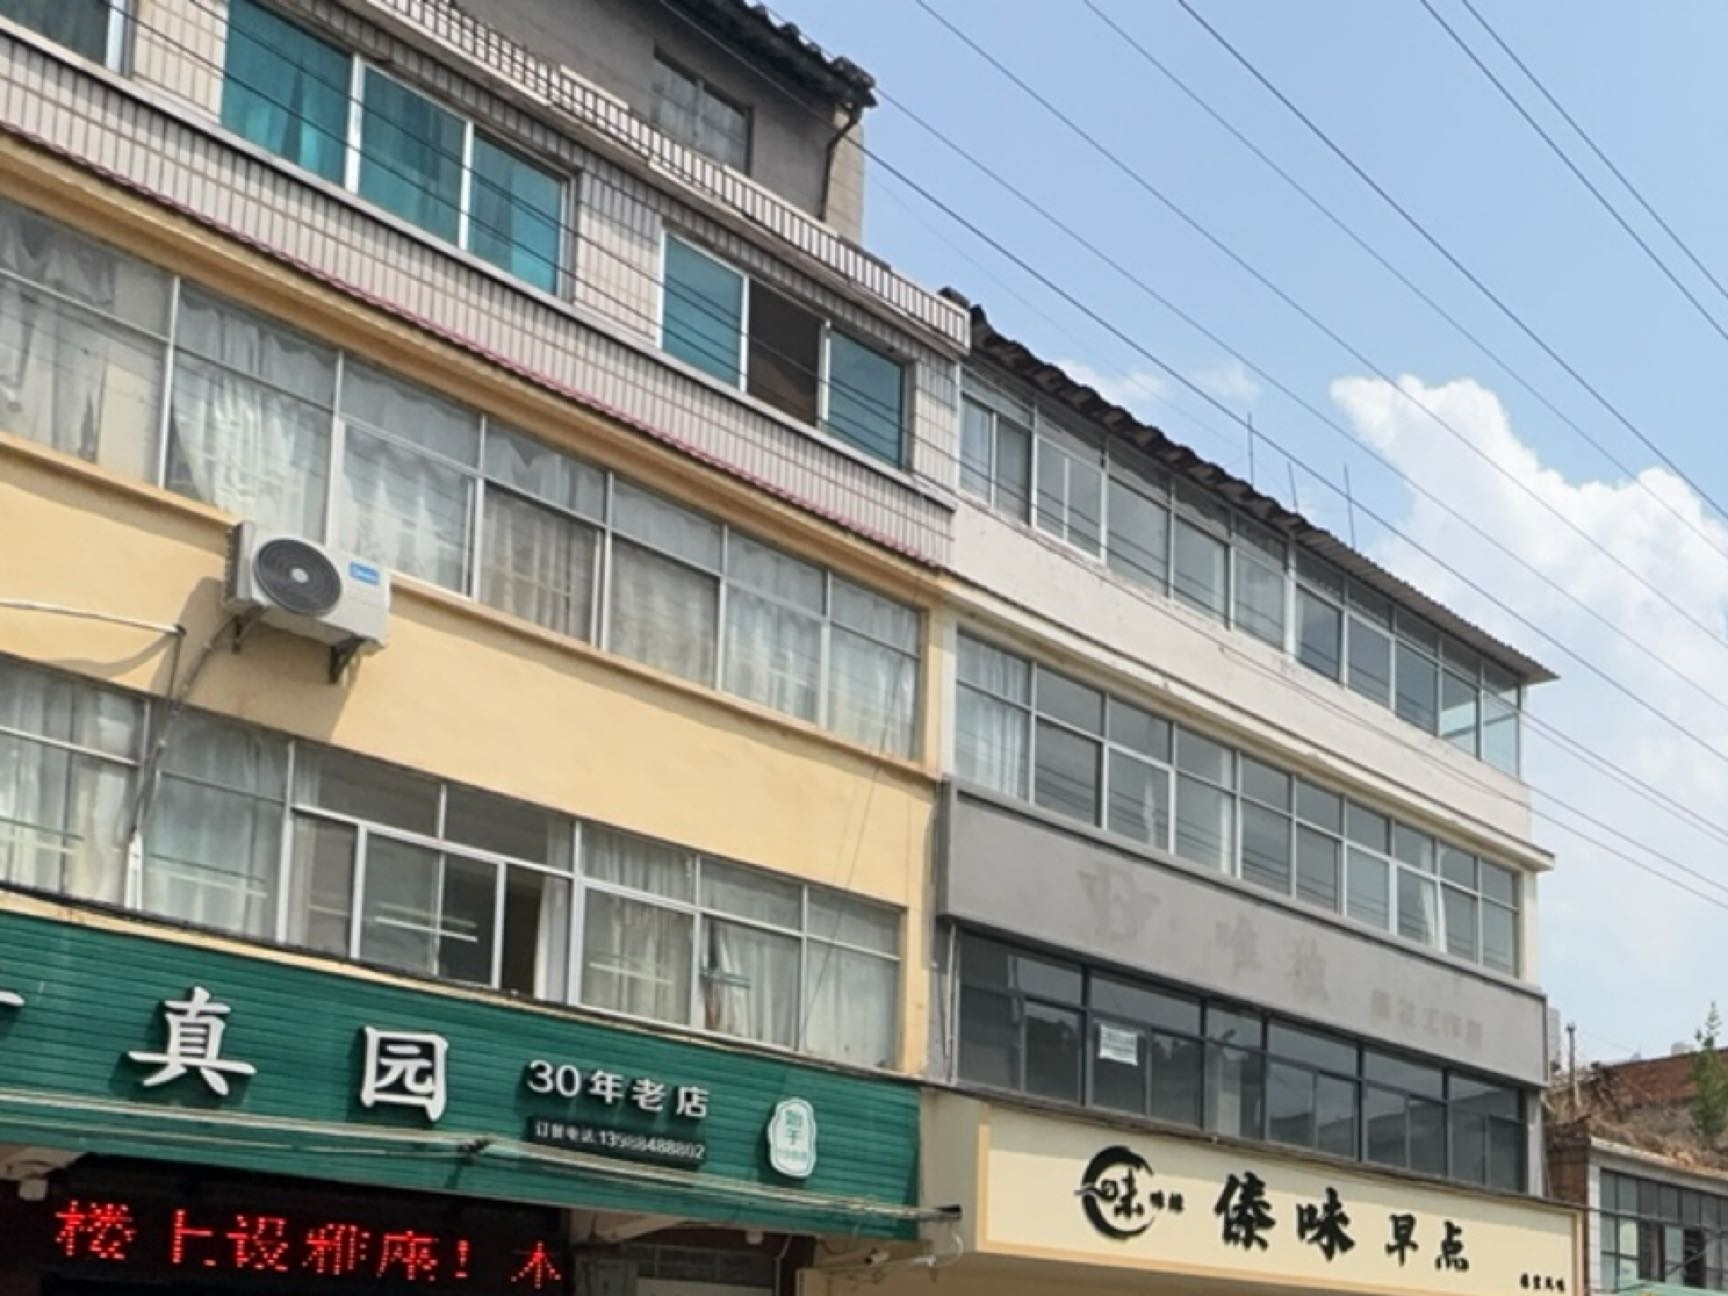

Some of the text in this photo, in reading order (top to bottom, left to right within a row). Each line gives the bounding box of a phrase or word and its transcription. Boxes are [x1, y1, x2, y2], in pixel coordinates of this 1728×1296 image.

[0, 985, 450, 1121] 真园
[526, 1058, 709, 1118] 30年老店
[1213, 1170, 1471, 1271] 傣味早点
